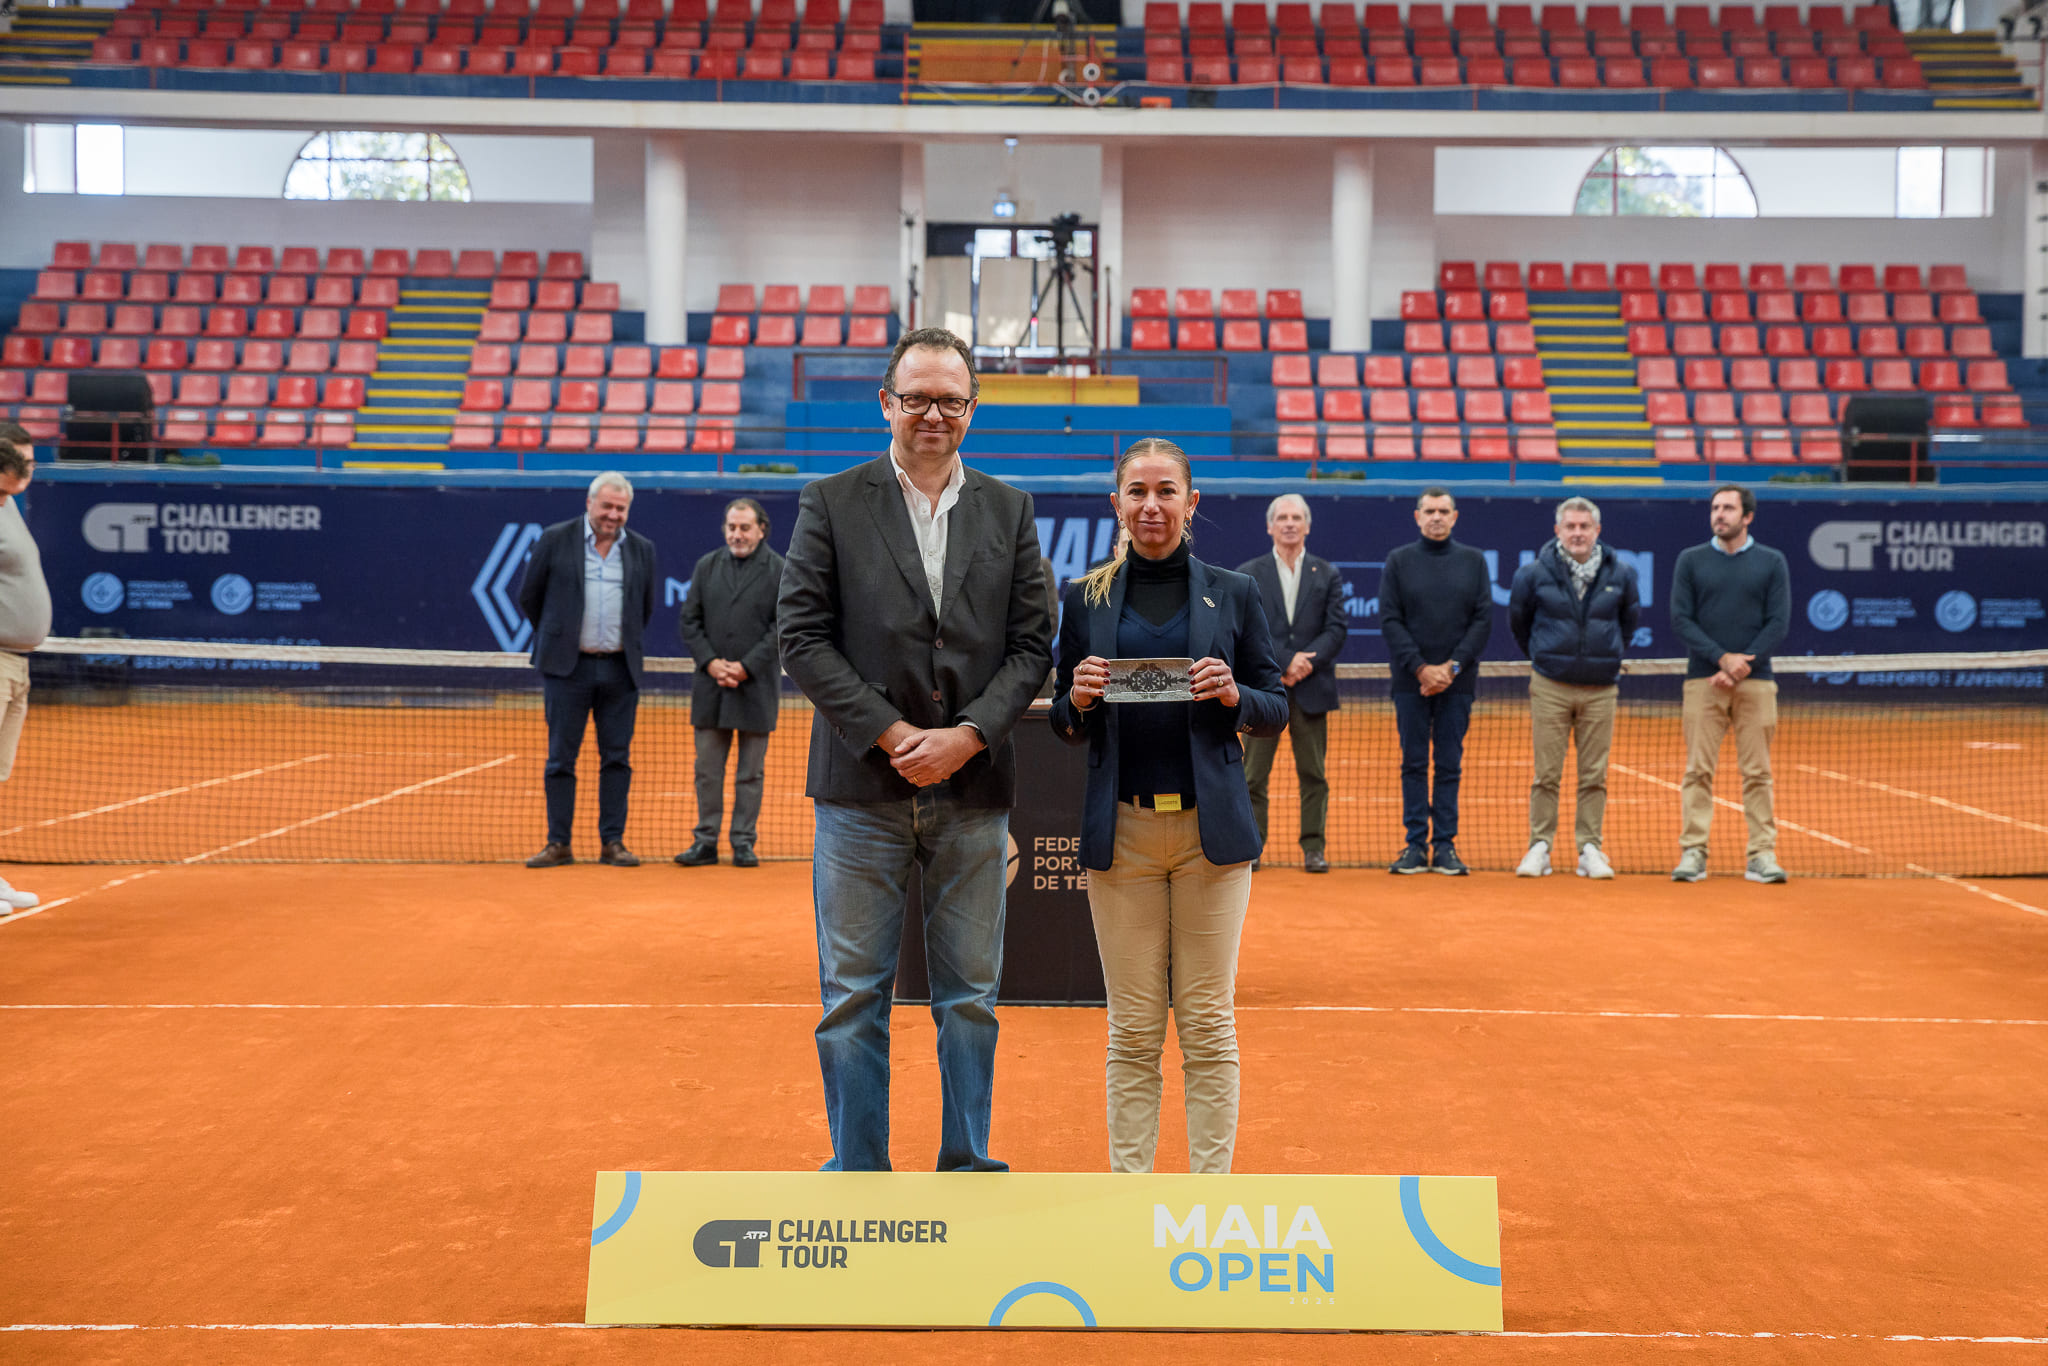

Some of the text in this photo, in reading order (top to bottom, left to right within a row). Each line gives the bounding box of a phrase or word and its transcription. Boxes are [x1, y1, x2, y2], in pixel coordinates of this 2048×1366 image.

[161, 503, 321, 530] CHALLENGER
[161, 529, 231, 554] TOUR
[1886, 521, 2046, 547] CHALLENGER
[1886, 546, 1955, 571] TOUR
[1034, 871, 1088, 890] DE TÉ
[742, 1230, 769, 1240] ATP
[778, 1219, 948, 1243] CHALLENGER
[1153, 1203, 1334, 1249] MAIA
[777, 1245, 848, 1268] TOUR
[1169, 1251, 1335, 1293] OPEN
